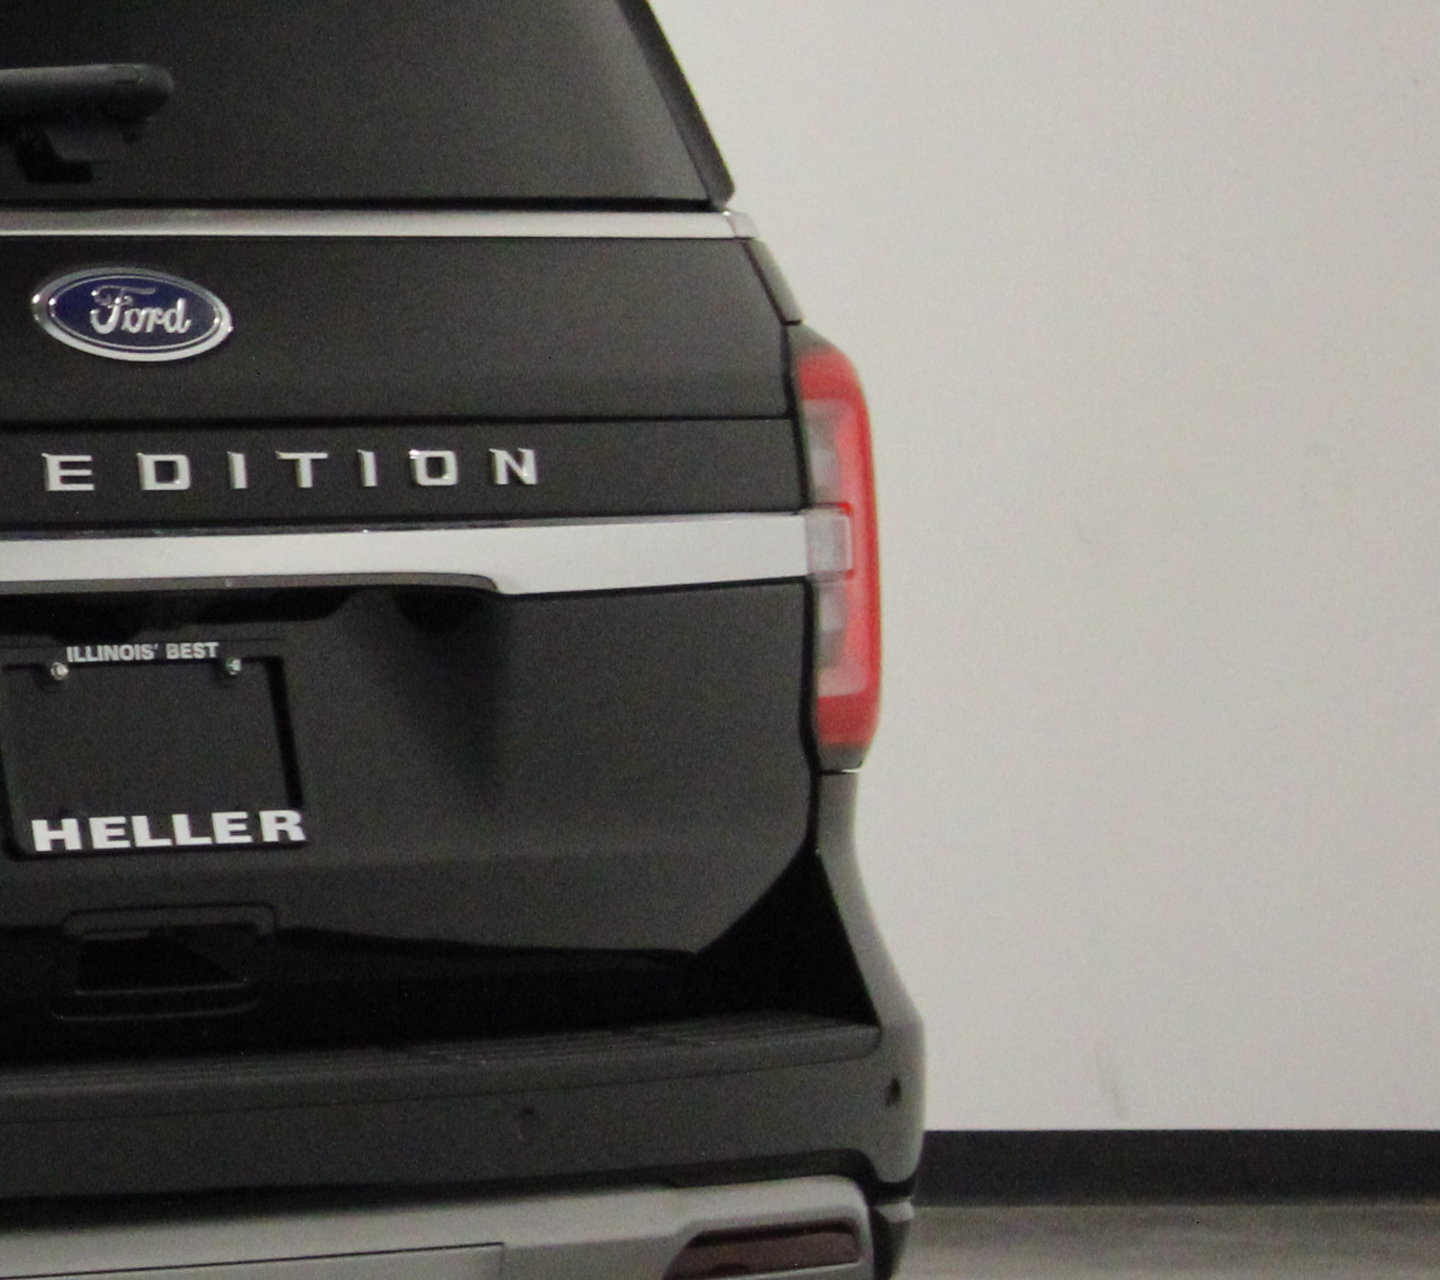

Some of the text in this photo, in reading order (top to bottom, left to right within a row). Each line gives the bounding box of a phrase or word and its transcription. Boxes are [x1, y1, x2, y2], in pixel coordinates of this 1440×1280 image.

[90, 284, 193, 334] Ford
[66, 641, 220, 663] ILLINOIS' BEST
[31, 809, 307, 852] HELLER
